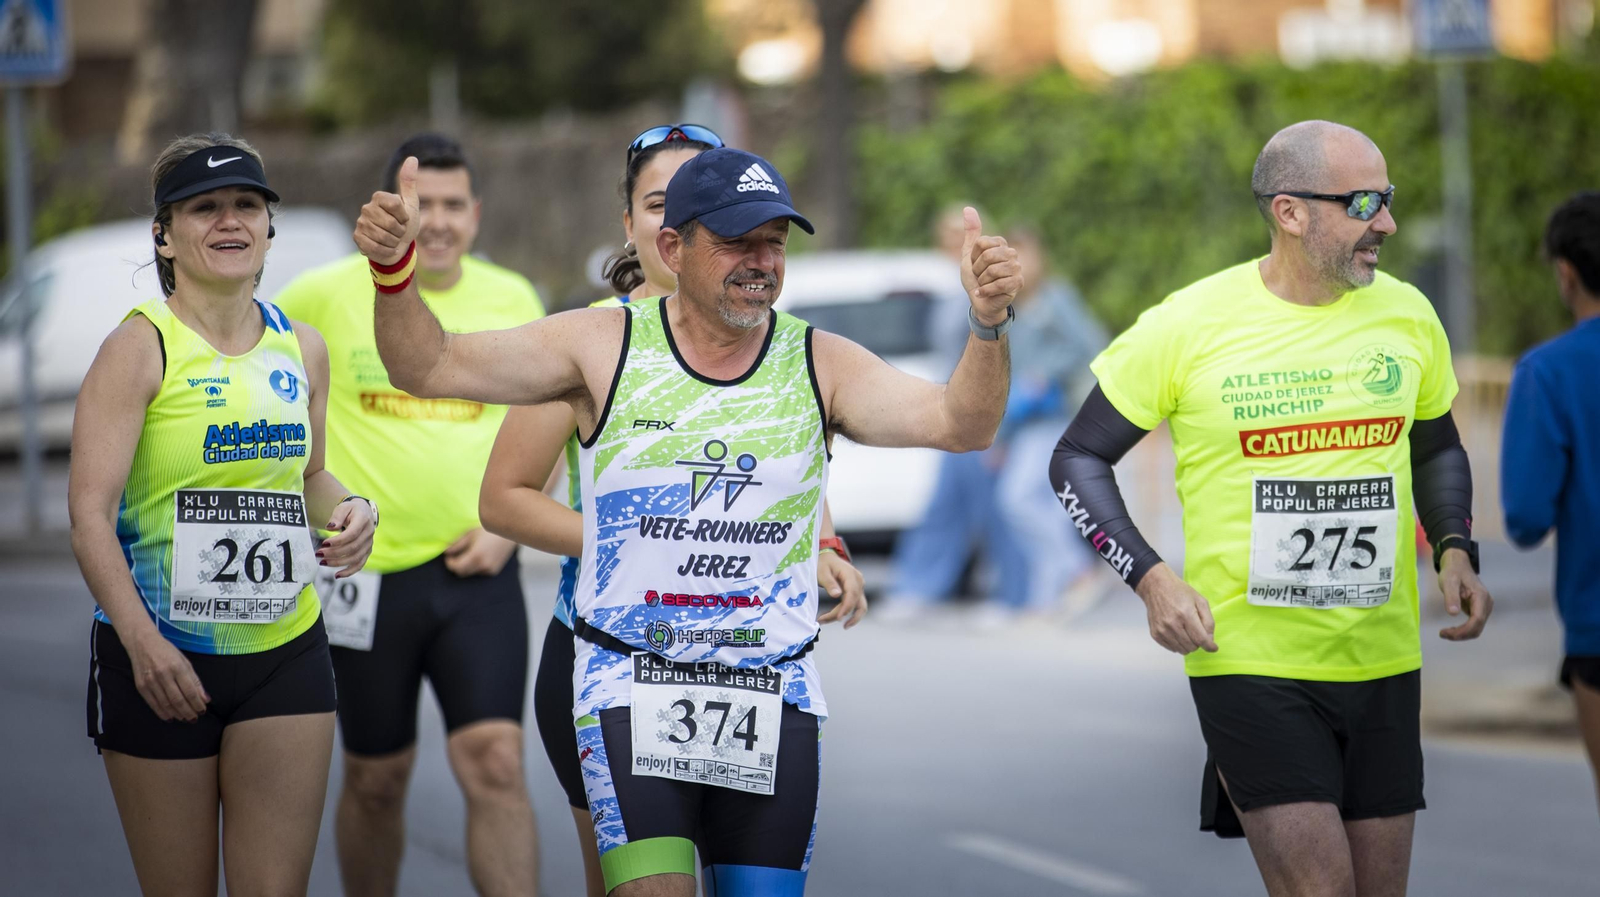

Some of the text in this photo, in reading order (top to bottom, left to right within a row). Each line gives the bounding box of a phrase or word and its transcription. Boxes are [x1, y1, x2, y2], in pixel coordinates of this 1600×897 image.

[737, 180, 779, 194] adidas
[1221, 368, 1333, 389] ATLETISMO
[1221, 385, 1334, 403] CIUDAD DE JEREZ
[1233, 399, 1325, 420] RUNCHIP
[203, 419, 306, 449] Atletismo
[632, 419, 676, 431] FRX
[203, 441, 306, 464] Ciudad de Jerez
[1262, 481, 1389, 497] XLV CARRERA
[184, 495, 300, 510] XLV CARRERA
[1262, 495, 1390, 511] POPULAR JEREZ
[184, 509, 302, 524] POPULAR JEREZ
[639, 515, 793, 544] VETE-RUNNERS
[1288, 526, 1378, 571] 275
[211, 537, 298, 584] 261
[677, 553, 751, 578] JEREZ
[321, 576, 358, 617] 79
[661, 593, 764, 608] SECOVISA
[1250, 584, 1289, 601] enjoy!
[173, 597, 212, 616] enjoy!
[641, 670, 775, 691] POPULAR JEREZ
[668, 698, 759, 752] 374
[636, 754, 671, 774] enjoy!
